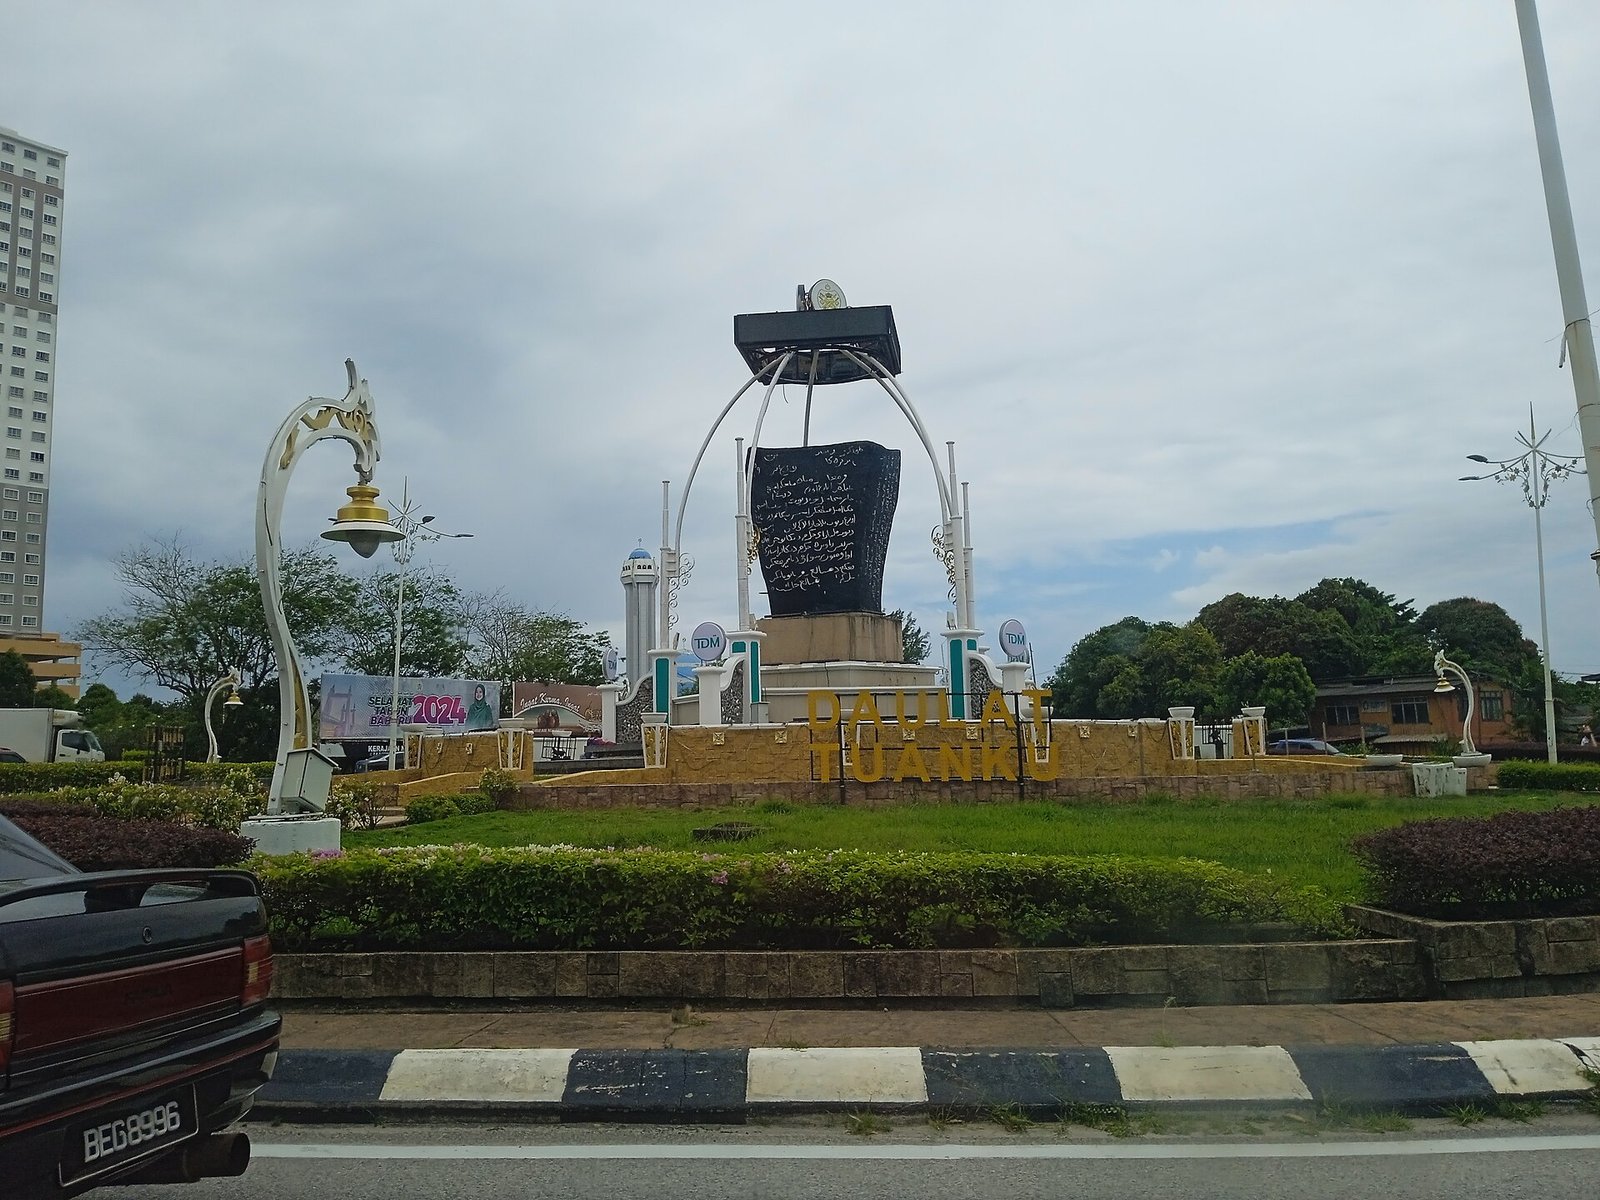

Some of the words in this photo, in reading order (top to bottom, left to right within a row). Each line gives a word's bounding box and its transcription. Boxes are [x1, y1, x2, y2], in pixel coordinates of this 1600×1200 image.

[694, 635, 720, 649] TDM
[1005, 632, 1025, 645] TDM
[370, 716, 412, 725] BAHRU
[411, 695, 467, 724] 2024
[808, 689, 1053, 731] DAULAT
[809, 742, 1059, 783] TUANKU
[83, 1101, 181, 1163] BEG8996
